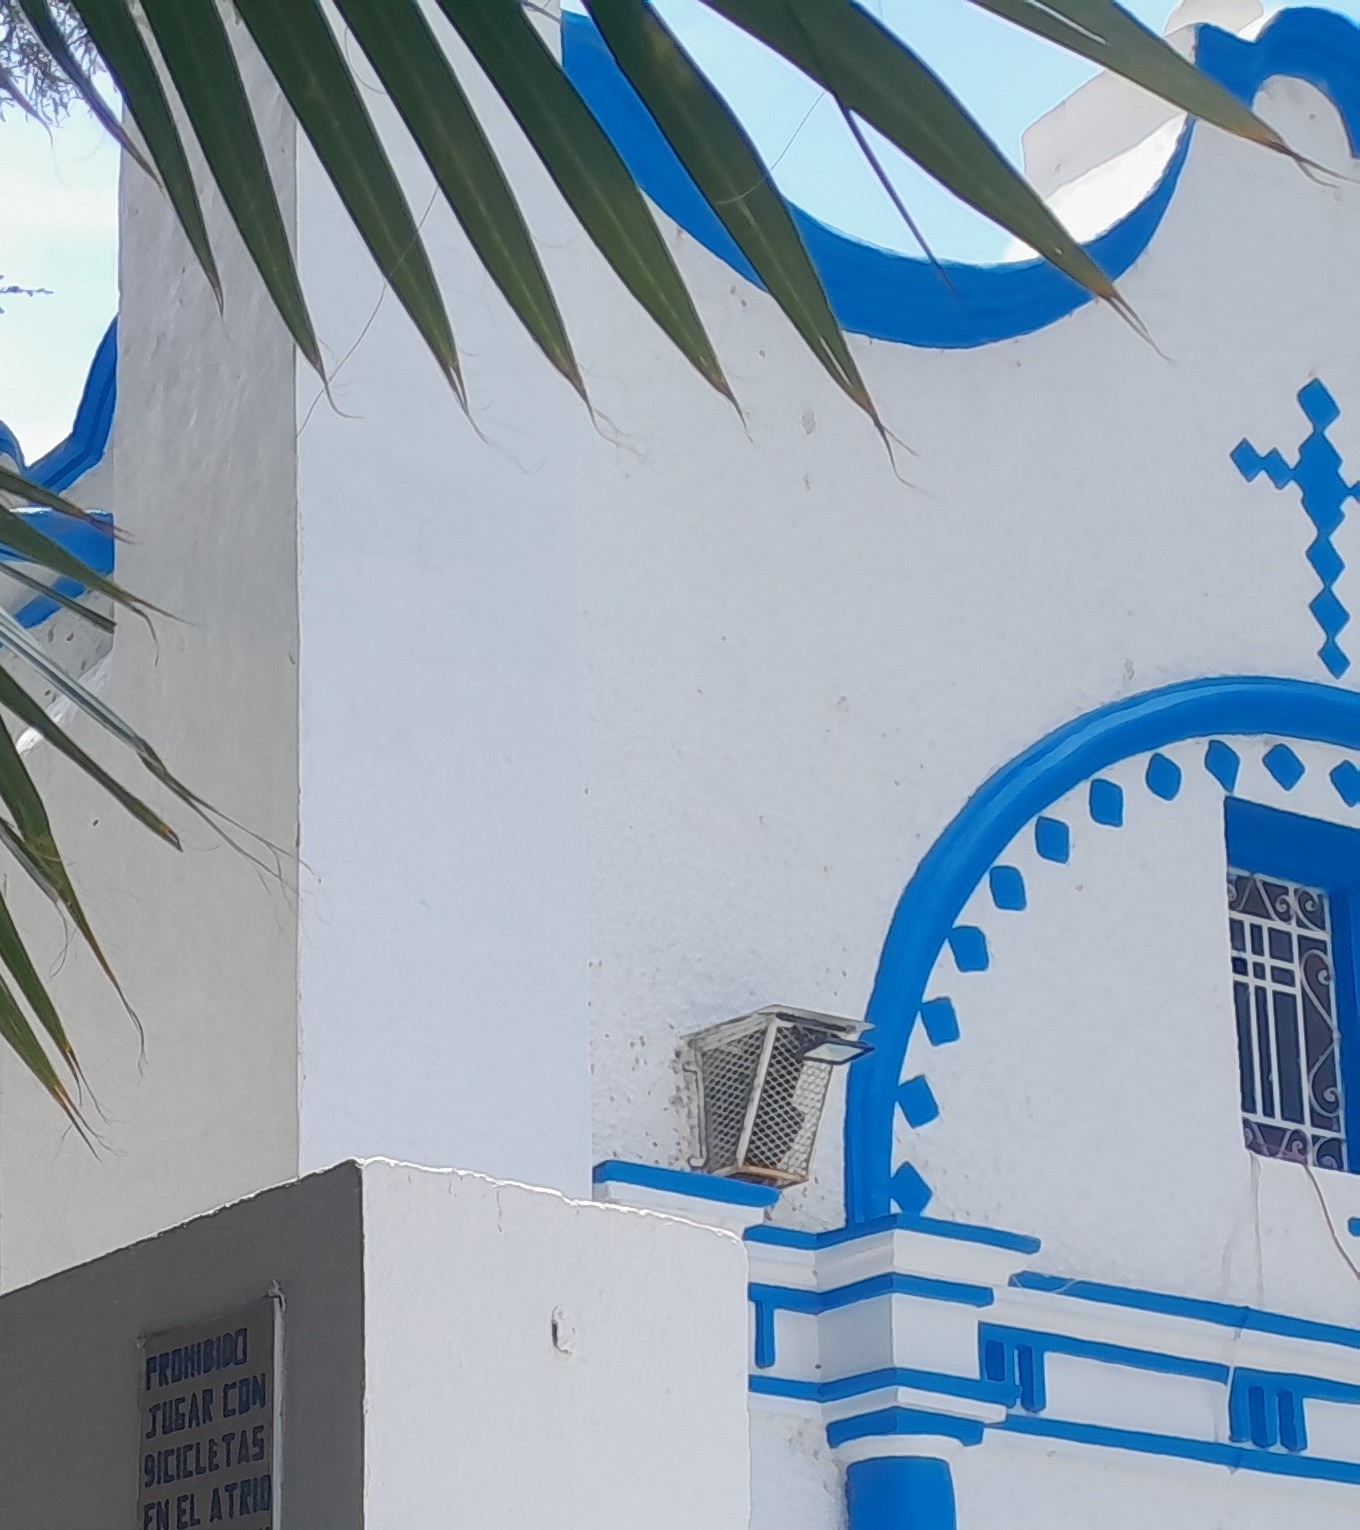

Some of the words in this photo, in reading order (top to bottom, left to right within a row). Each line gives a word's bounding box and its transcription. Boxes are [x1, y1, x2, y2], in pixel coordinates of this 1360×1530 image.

[146, 1327, 248, 1391] PROHIBIDO
[145, 1388, 213, 1439] JUGAR
[223, 1372, 266, 1418] CON
[176, 1493, 201, 1530] EL
[209, 1474, 271, 1523] ATRIO
